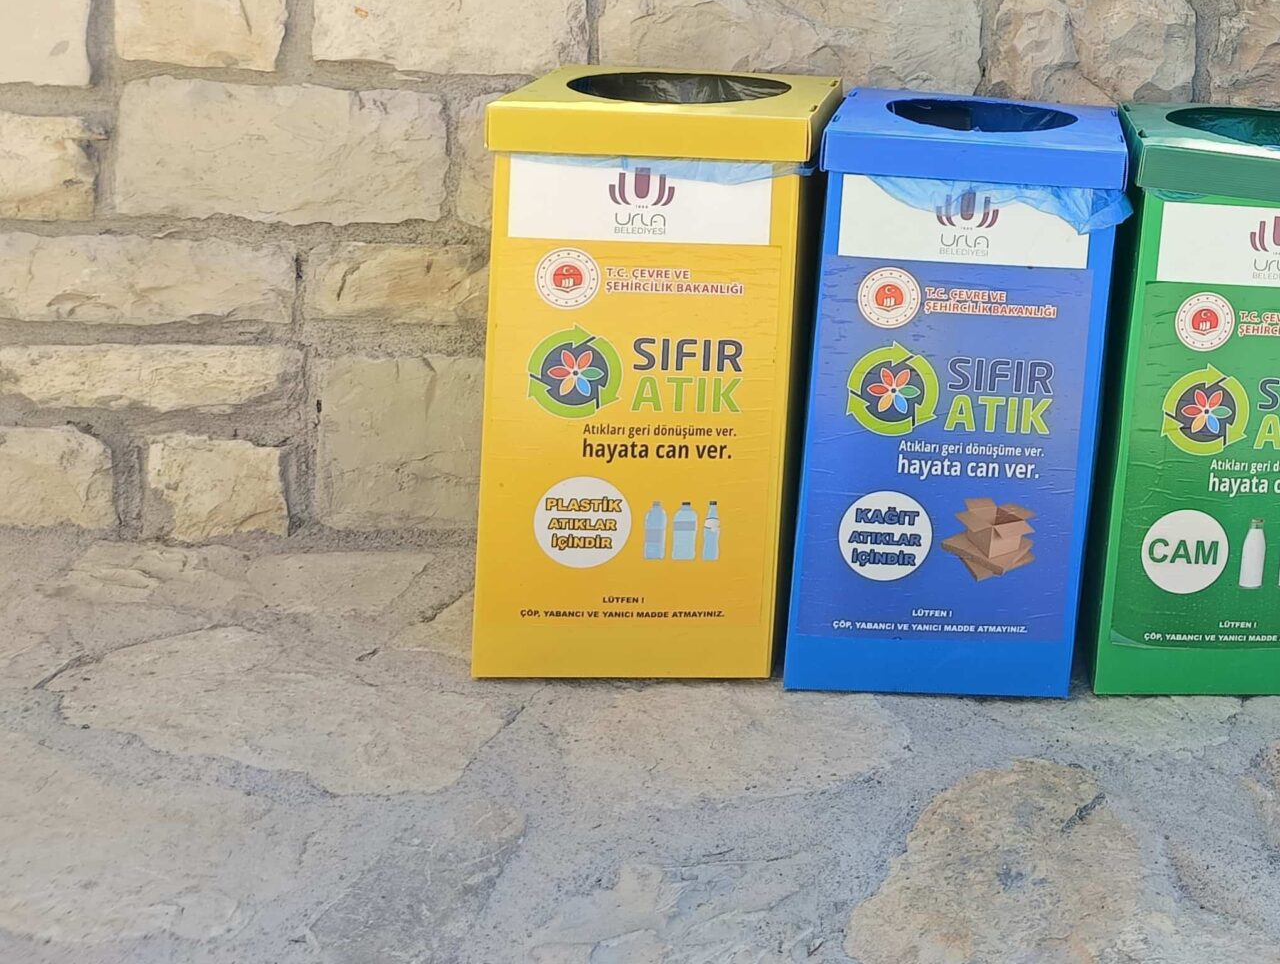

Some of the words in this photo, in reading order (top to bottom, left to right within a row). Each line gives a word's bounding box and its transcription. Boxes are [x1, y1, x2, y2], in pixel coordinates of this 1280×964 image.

[606, 268, 628, 278] T.C.
[674, 269, 690, 280] VE
[925, 288, 947, 300] T.C.
[990, 291, 1007, 302] VE
[1240, 311, 1260, 323] T.C.
[632, 337, 743, 373] SIFIR
[948, 357, 1055, 395] SIFIR
[631, 376, 744, 413] ATIK
[943, 394, 1053, 435] ATIK
[583, 424, 626, 435] Atıkları
[628, 424, 650, 439] geri
[653, 425, 713, 440] dönüşüme
[715, 427, 737, 437] ver.
[582, 439, 649, 463] hayata
[655, 443, 689, 459] can
[695, 444, 733, 460] ver.
[899, 440, 939, 454] Atıkları
[941, 441, 963, 457] geri
[965, 442, 1022, 459] dönüşüme
[1024, 446, 1045, 458] ver.
[897, 454, 961, 480] hayata
[967, 461, 1000, 478] can
[1005, 462, 1040, 479] ver.
[1210, 459, 1248, 471] Atıkları
[1250, 460, 1271, 473] geri
[1208, 473, 1268, 497] hayata
[545, 496, 622, 513] PLASTİK
[548, 518, 617, 531] ATIKLAR
[855, 506, 919, 526] KAĞIT
[551, 534, 612, 550] İÇİNDİR
[849, 530, 922, 547] ATIKLAR
[851, 548, 916, 567] İÇİNDİR
[1148, 538, 1220, 565] CAM
[602, 596, 639, 604] LÜTFEN
[543, 610, 585, 618] YABANCI
[912, 608, 947, 618] LÜTFEN
[855, 622, 895, 630] YABANCI
[897, 623, 909, 631] VE
[944, 624, 975, 632] MADDE
[1219, 620, 1252, 628] LÜTFEN
